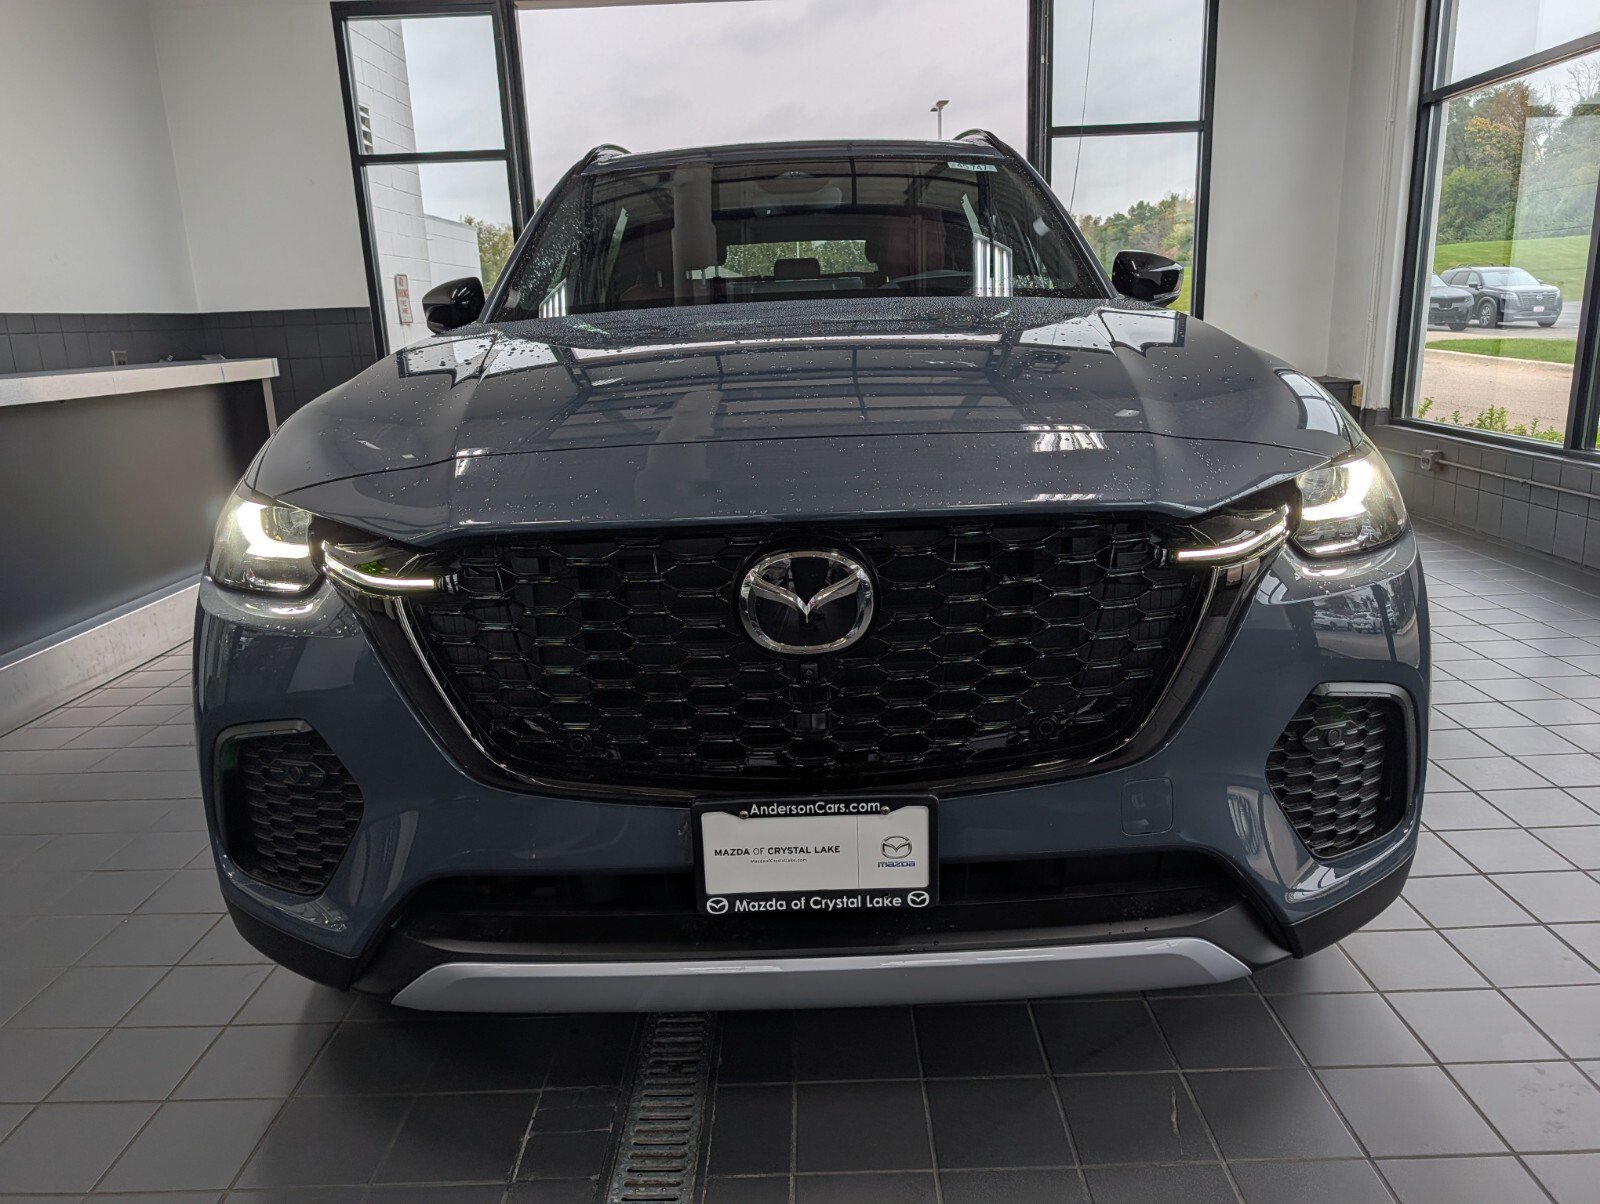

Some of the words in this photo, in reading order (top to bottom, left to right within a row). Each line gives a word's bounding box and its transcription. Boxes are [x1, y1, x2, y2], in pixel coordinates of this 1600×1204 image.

[750, 801, 881, 816] AndersonCars.com
[714, 848, 751, 857] MAZDA
[752, 847, 766, 856] OF
[767, 846, 812, 855] CRYSTAL
[814, 845, 841, 854] LAKE
[734, 898, 787, 912] Mazda
[791, 896, 806, 910] of
[809, 895, 861, 912] Crystal
[866, 895, 902, 908] Lake
